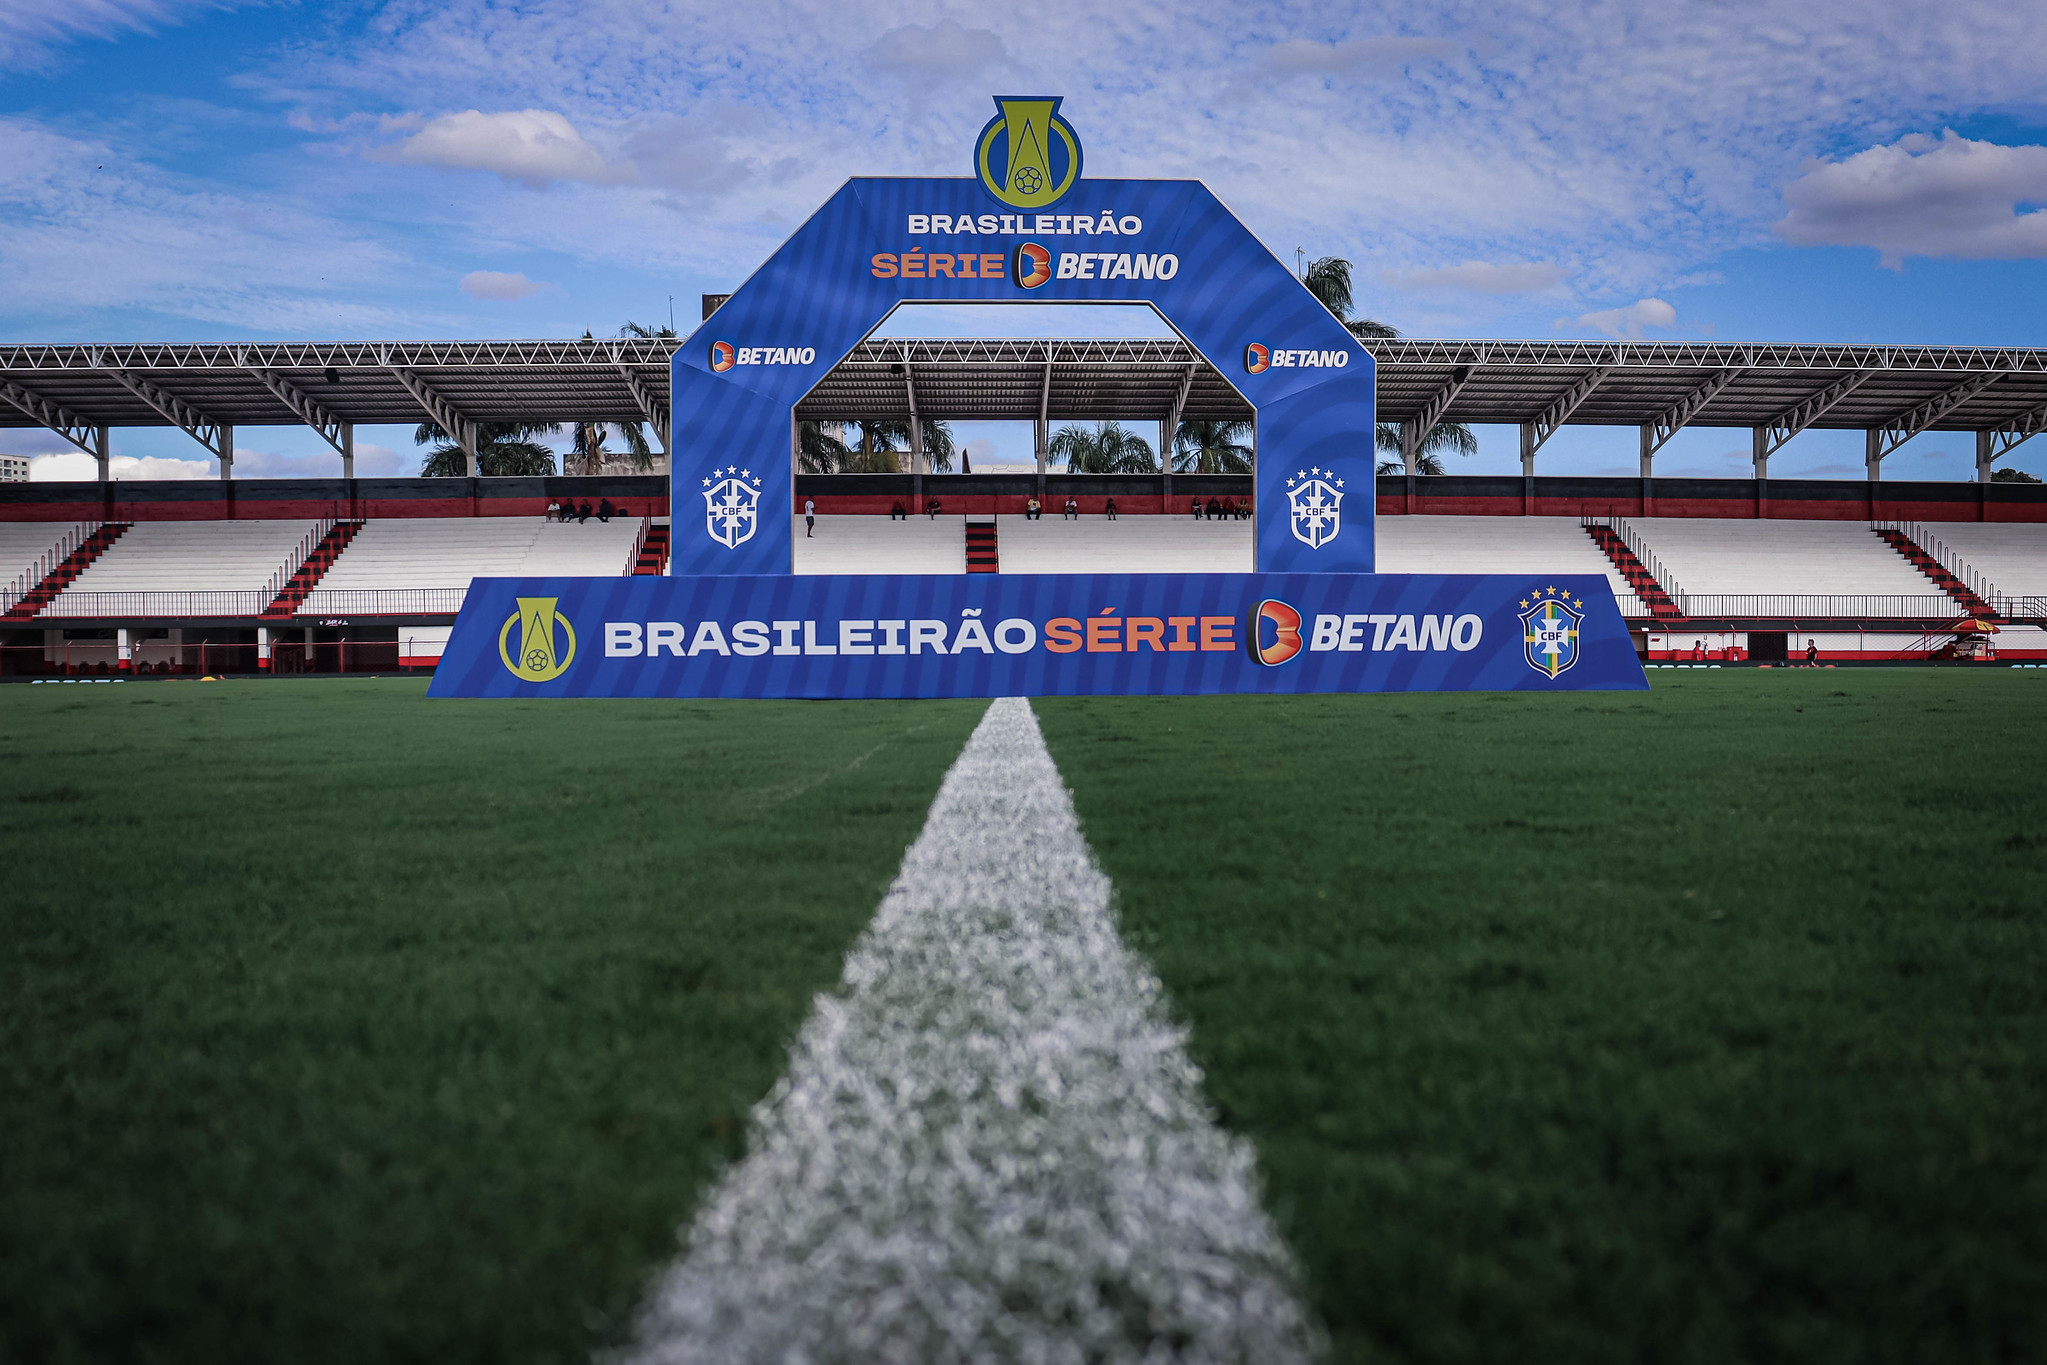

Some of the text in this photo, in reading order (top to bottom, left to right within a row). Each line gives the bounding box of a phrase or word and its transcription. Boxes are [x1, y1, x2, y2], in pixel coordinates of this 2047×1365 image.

[908, 210, 1142, 235] BRASILEIRÃO
[871, 247, 1179, 281] SÉRIE BETANO
[736, 347, 816, 365] BETANO
[1270, 350, 1349, 367] BETANO
[722, 507, 742, 516] CBF
[1305, 508, 1326, 516] CBF
[604, 608, 1483, 657] BRASILEIRÃO SÉRIE BETANO
[1540, 631, 1563, 641] CBF
